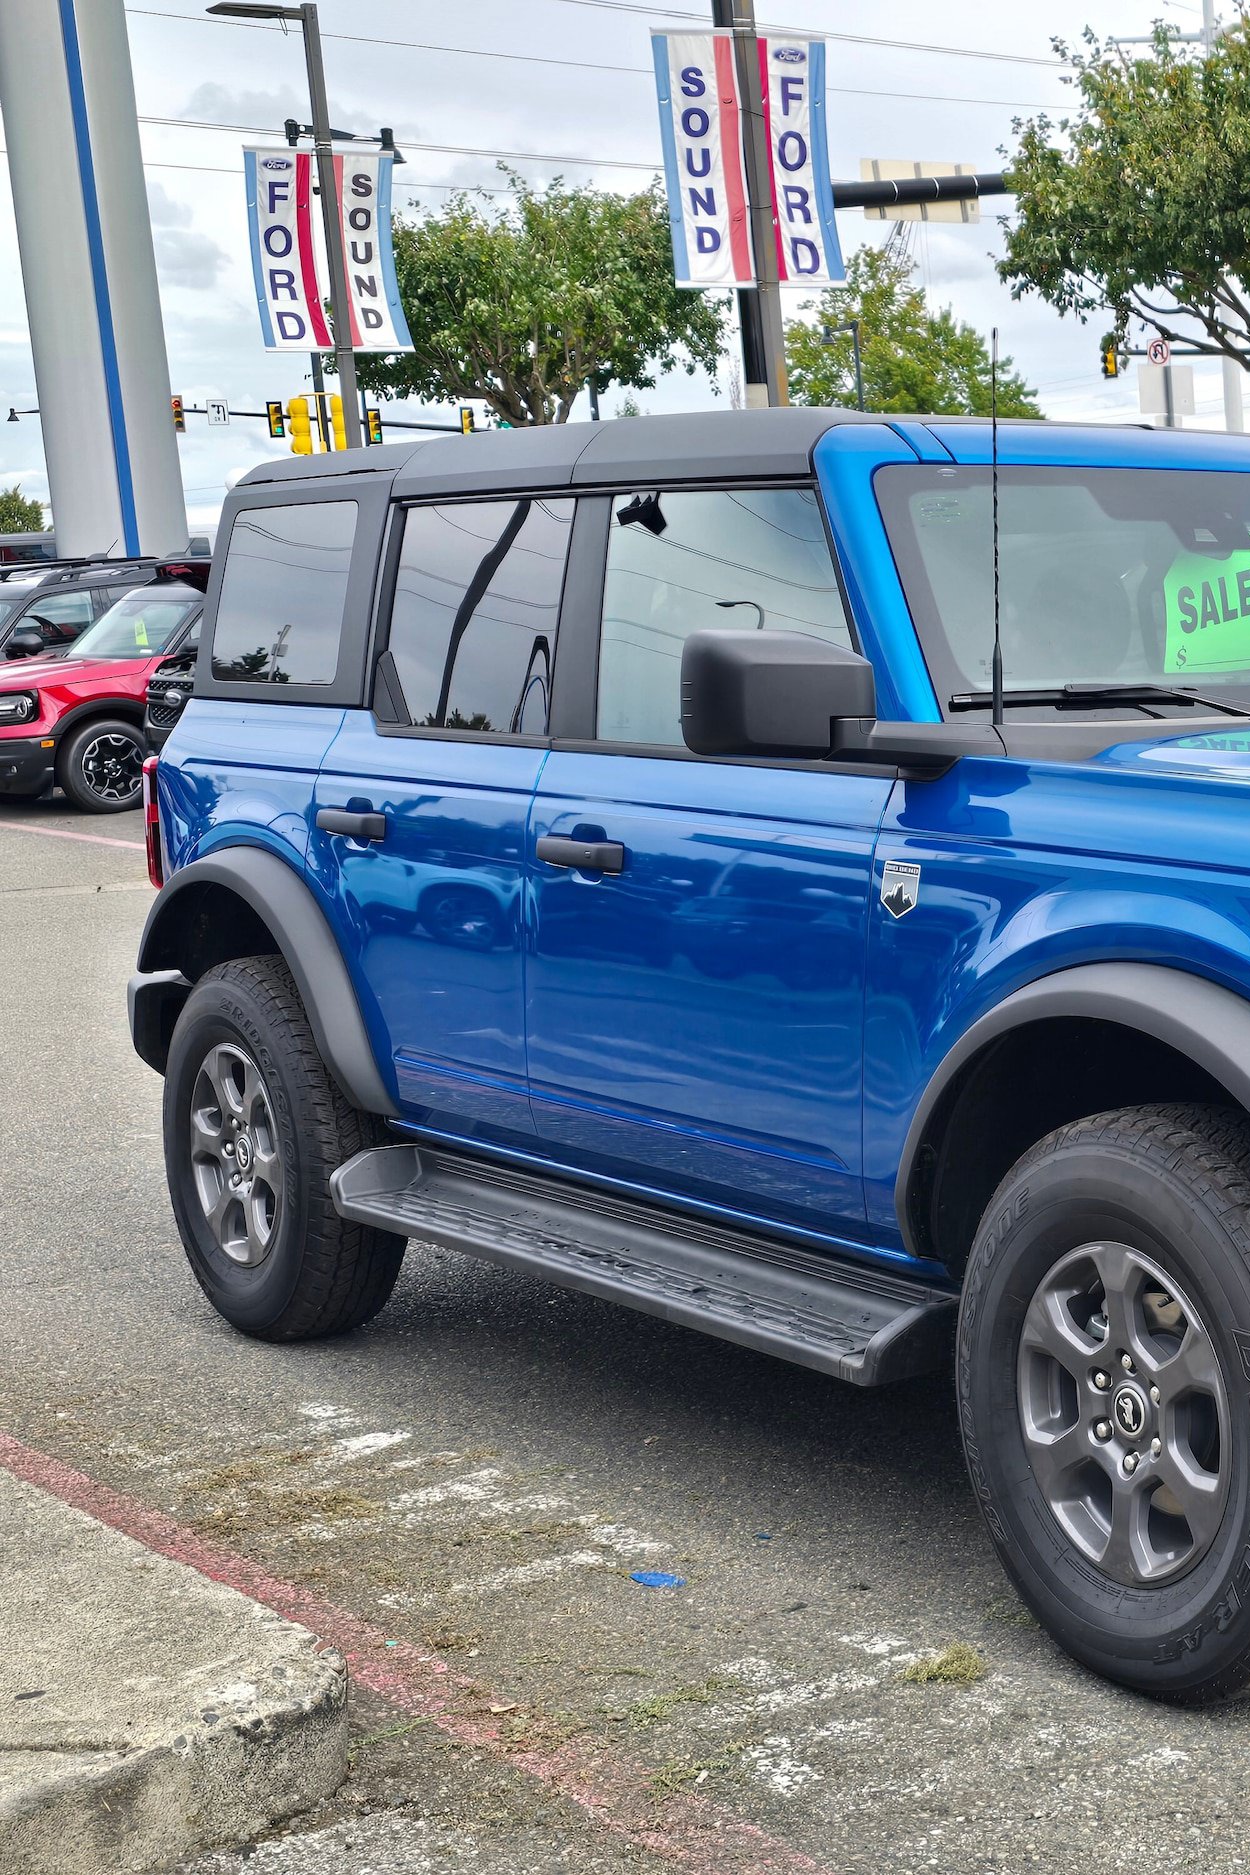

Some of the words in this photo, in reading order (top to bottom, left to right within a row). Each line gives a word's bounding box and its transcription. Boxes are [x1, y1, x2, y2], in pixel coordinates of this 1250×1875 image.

[779, 49, 802, 62] Ford
[266, 159, 287, 170] Ford
[681, 66, 721, 254] SOUND
[778, 76, 821, 275] FORD
[263, 181, 306, 340] FORD
[349, 173, 384, 329] SOUND
[1176, 645, 1187, 669] $
